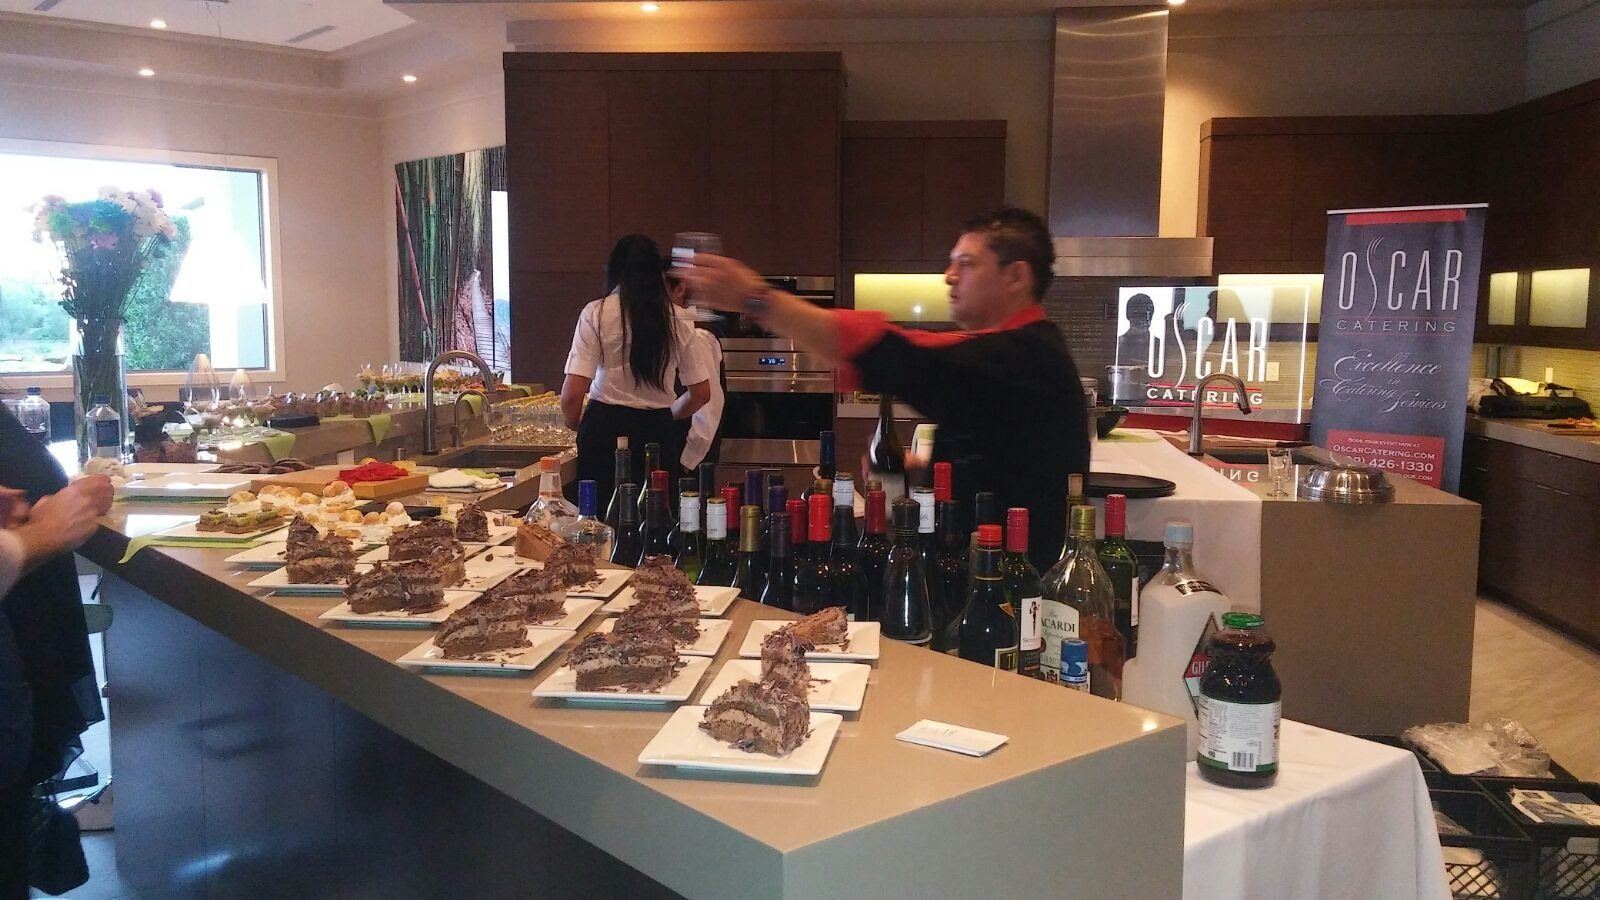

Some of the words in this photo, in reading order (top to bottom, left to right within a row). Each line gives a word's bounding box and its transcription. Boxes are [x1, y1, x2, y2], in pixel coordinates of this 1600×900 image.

[1338, 236, 1463, 319] OSCAR
[1336, 319, 1456, 333] CATERING
[1148, 301, 1268, 387] OSCAR
[1333, 349, 1442, 382] Excellence
[1319, 379, 1399, 401] Catering
[1387, 376, 1401, 385] in
[1383, 389, 1448, 413] Services
[1368, 458, 1434, 472] 426-1330
